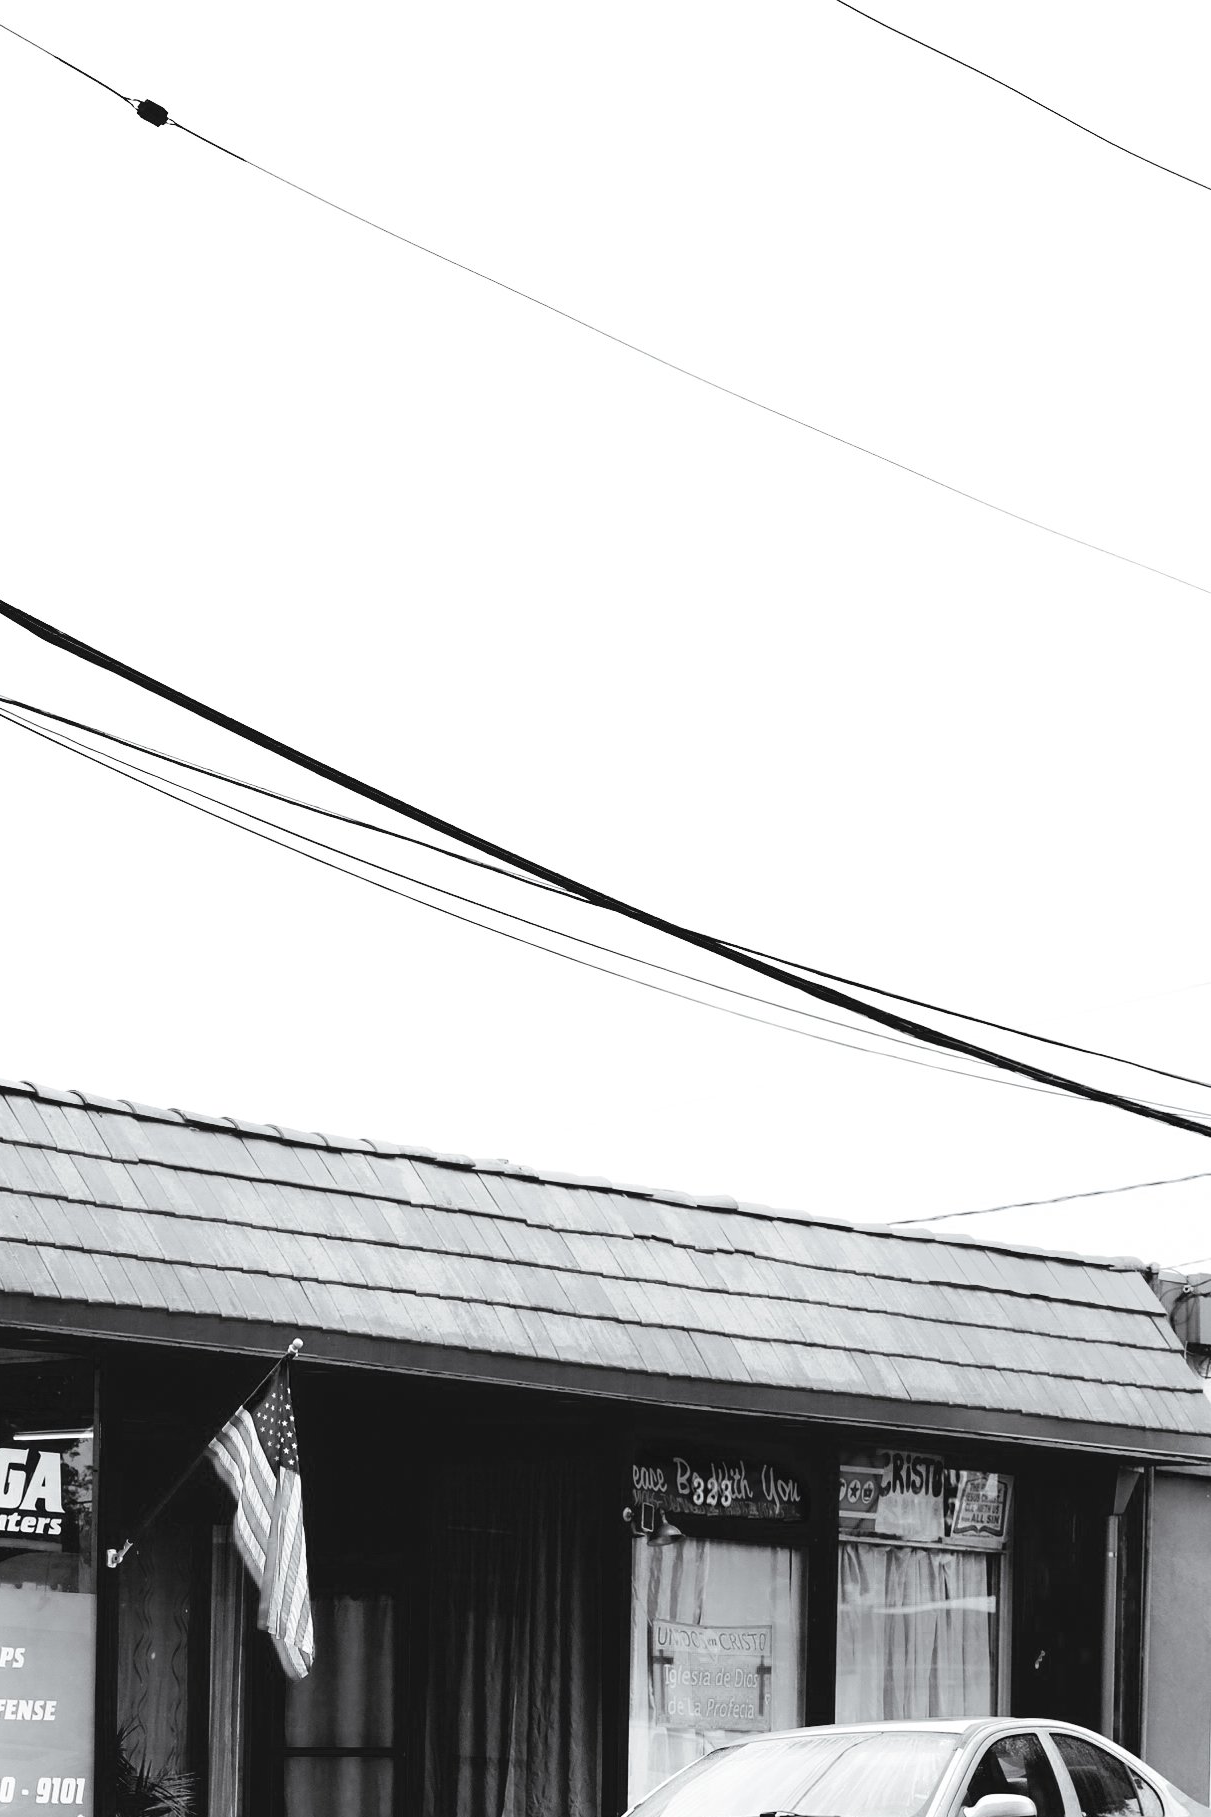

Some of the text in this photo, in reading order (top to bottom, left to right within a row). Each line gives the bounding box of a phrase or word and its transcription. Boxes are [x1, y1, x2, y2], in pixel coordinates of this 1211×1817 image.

[693, 1477, 733, 1508] 323
[761, 1464, 802, 1515] You
[971, 1514, 986, 1524] ALL
[986, 1515, 1000, 1525] SIN
[719, 1632, 768, 1652] CRISTO
[664, 1664, 759, 1689] Iglesia de Dios
[668, 1696, 686, 1716] de
[35, 1777, 86, 1804] 9101
